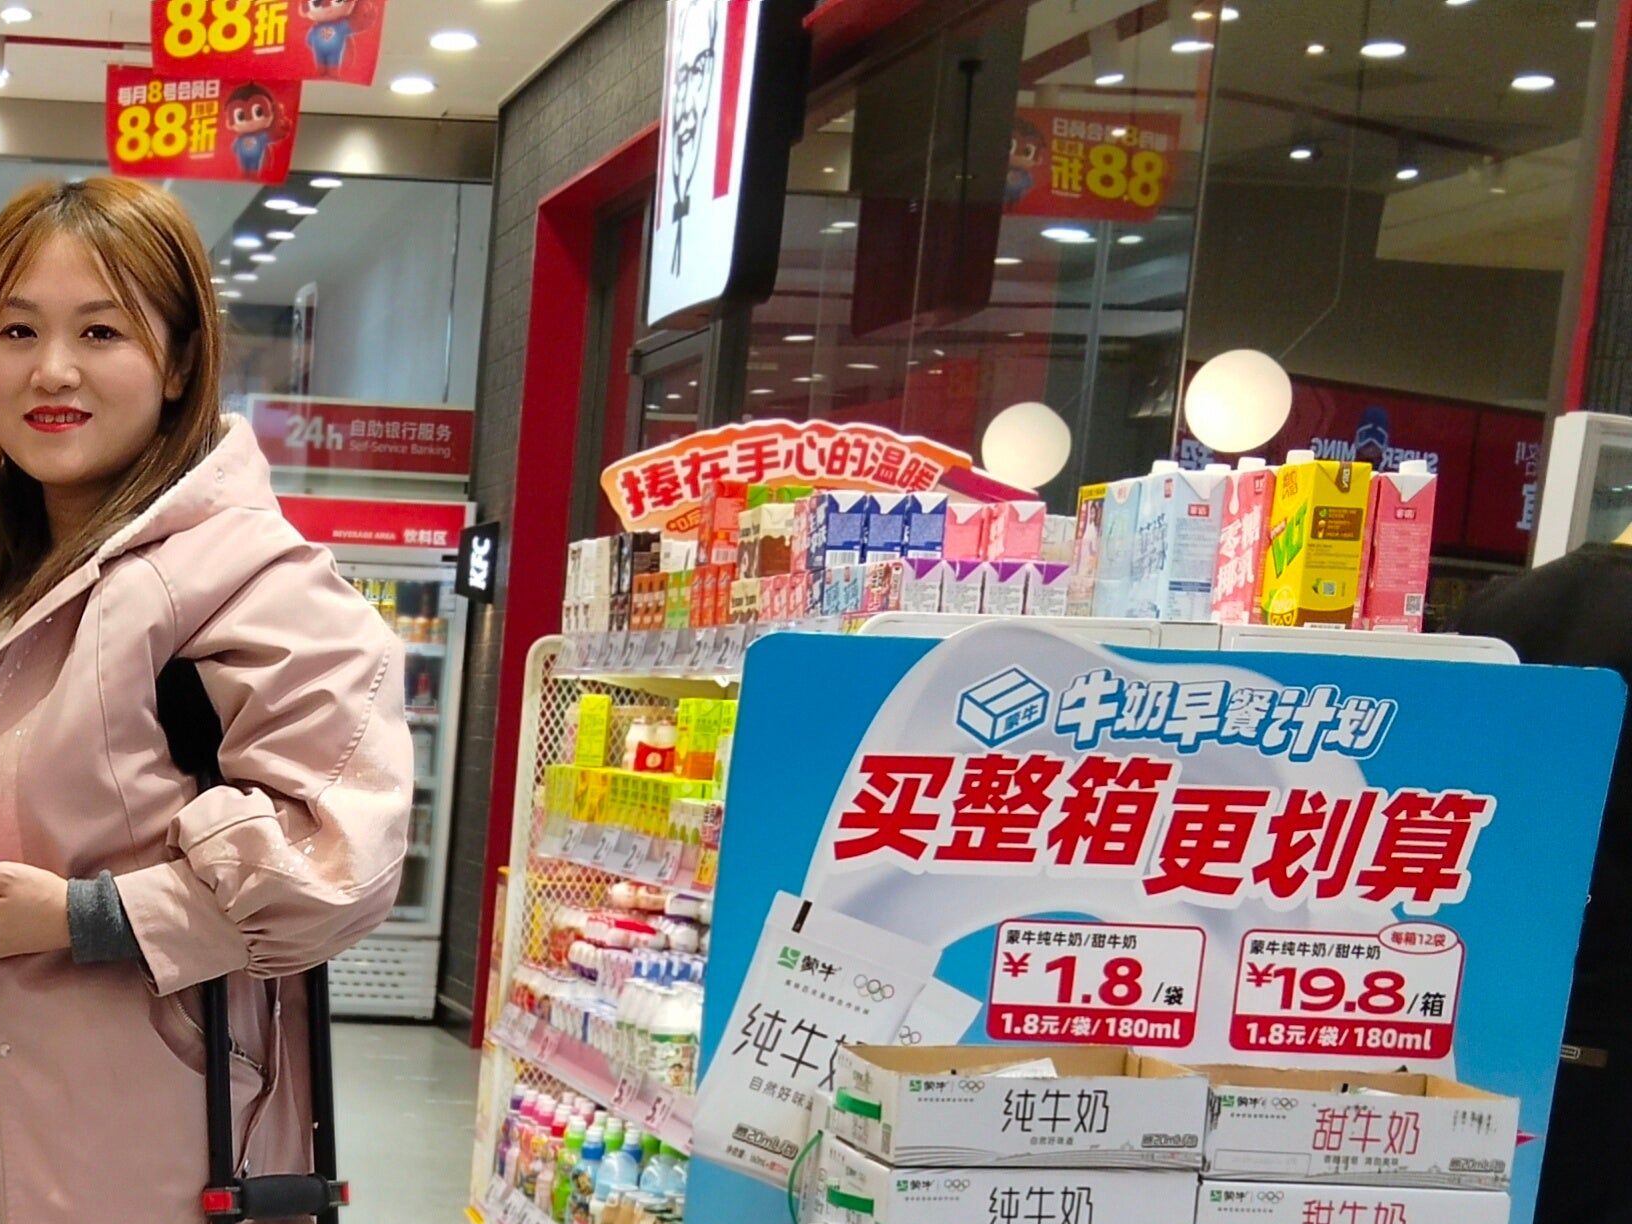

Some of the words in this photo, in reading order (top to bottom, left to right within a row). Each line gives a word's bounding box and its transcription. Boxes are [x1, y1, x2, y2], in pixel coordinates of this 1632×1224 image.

[349, 419, 452, 442] 自助银行服务
[411, 444, 452, 458] Banking
[403, 529, 448, 545] 饮料区
[469, 535, 492, 591] KFC
[1057, 669, 1395, 759] 牛奶早餐计划
[832, 754, 1487, 903] 买整箱更划算
[1006, 929, 1137, 951] 蒙牛纯牛奶/甜牛奶
[1249, 939, 1381, 960] 蒙牛纯牛奶/甜牛奶
[1391, 931, 1445, 948] 每箱12袋
[800, 954, 840, 982] 蒙牛
[1001, 1089, 1110, 1133] 纯牛奶
[1312, 1107, 1420, 1154] 甜牛奶
